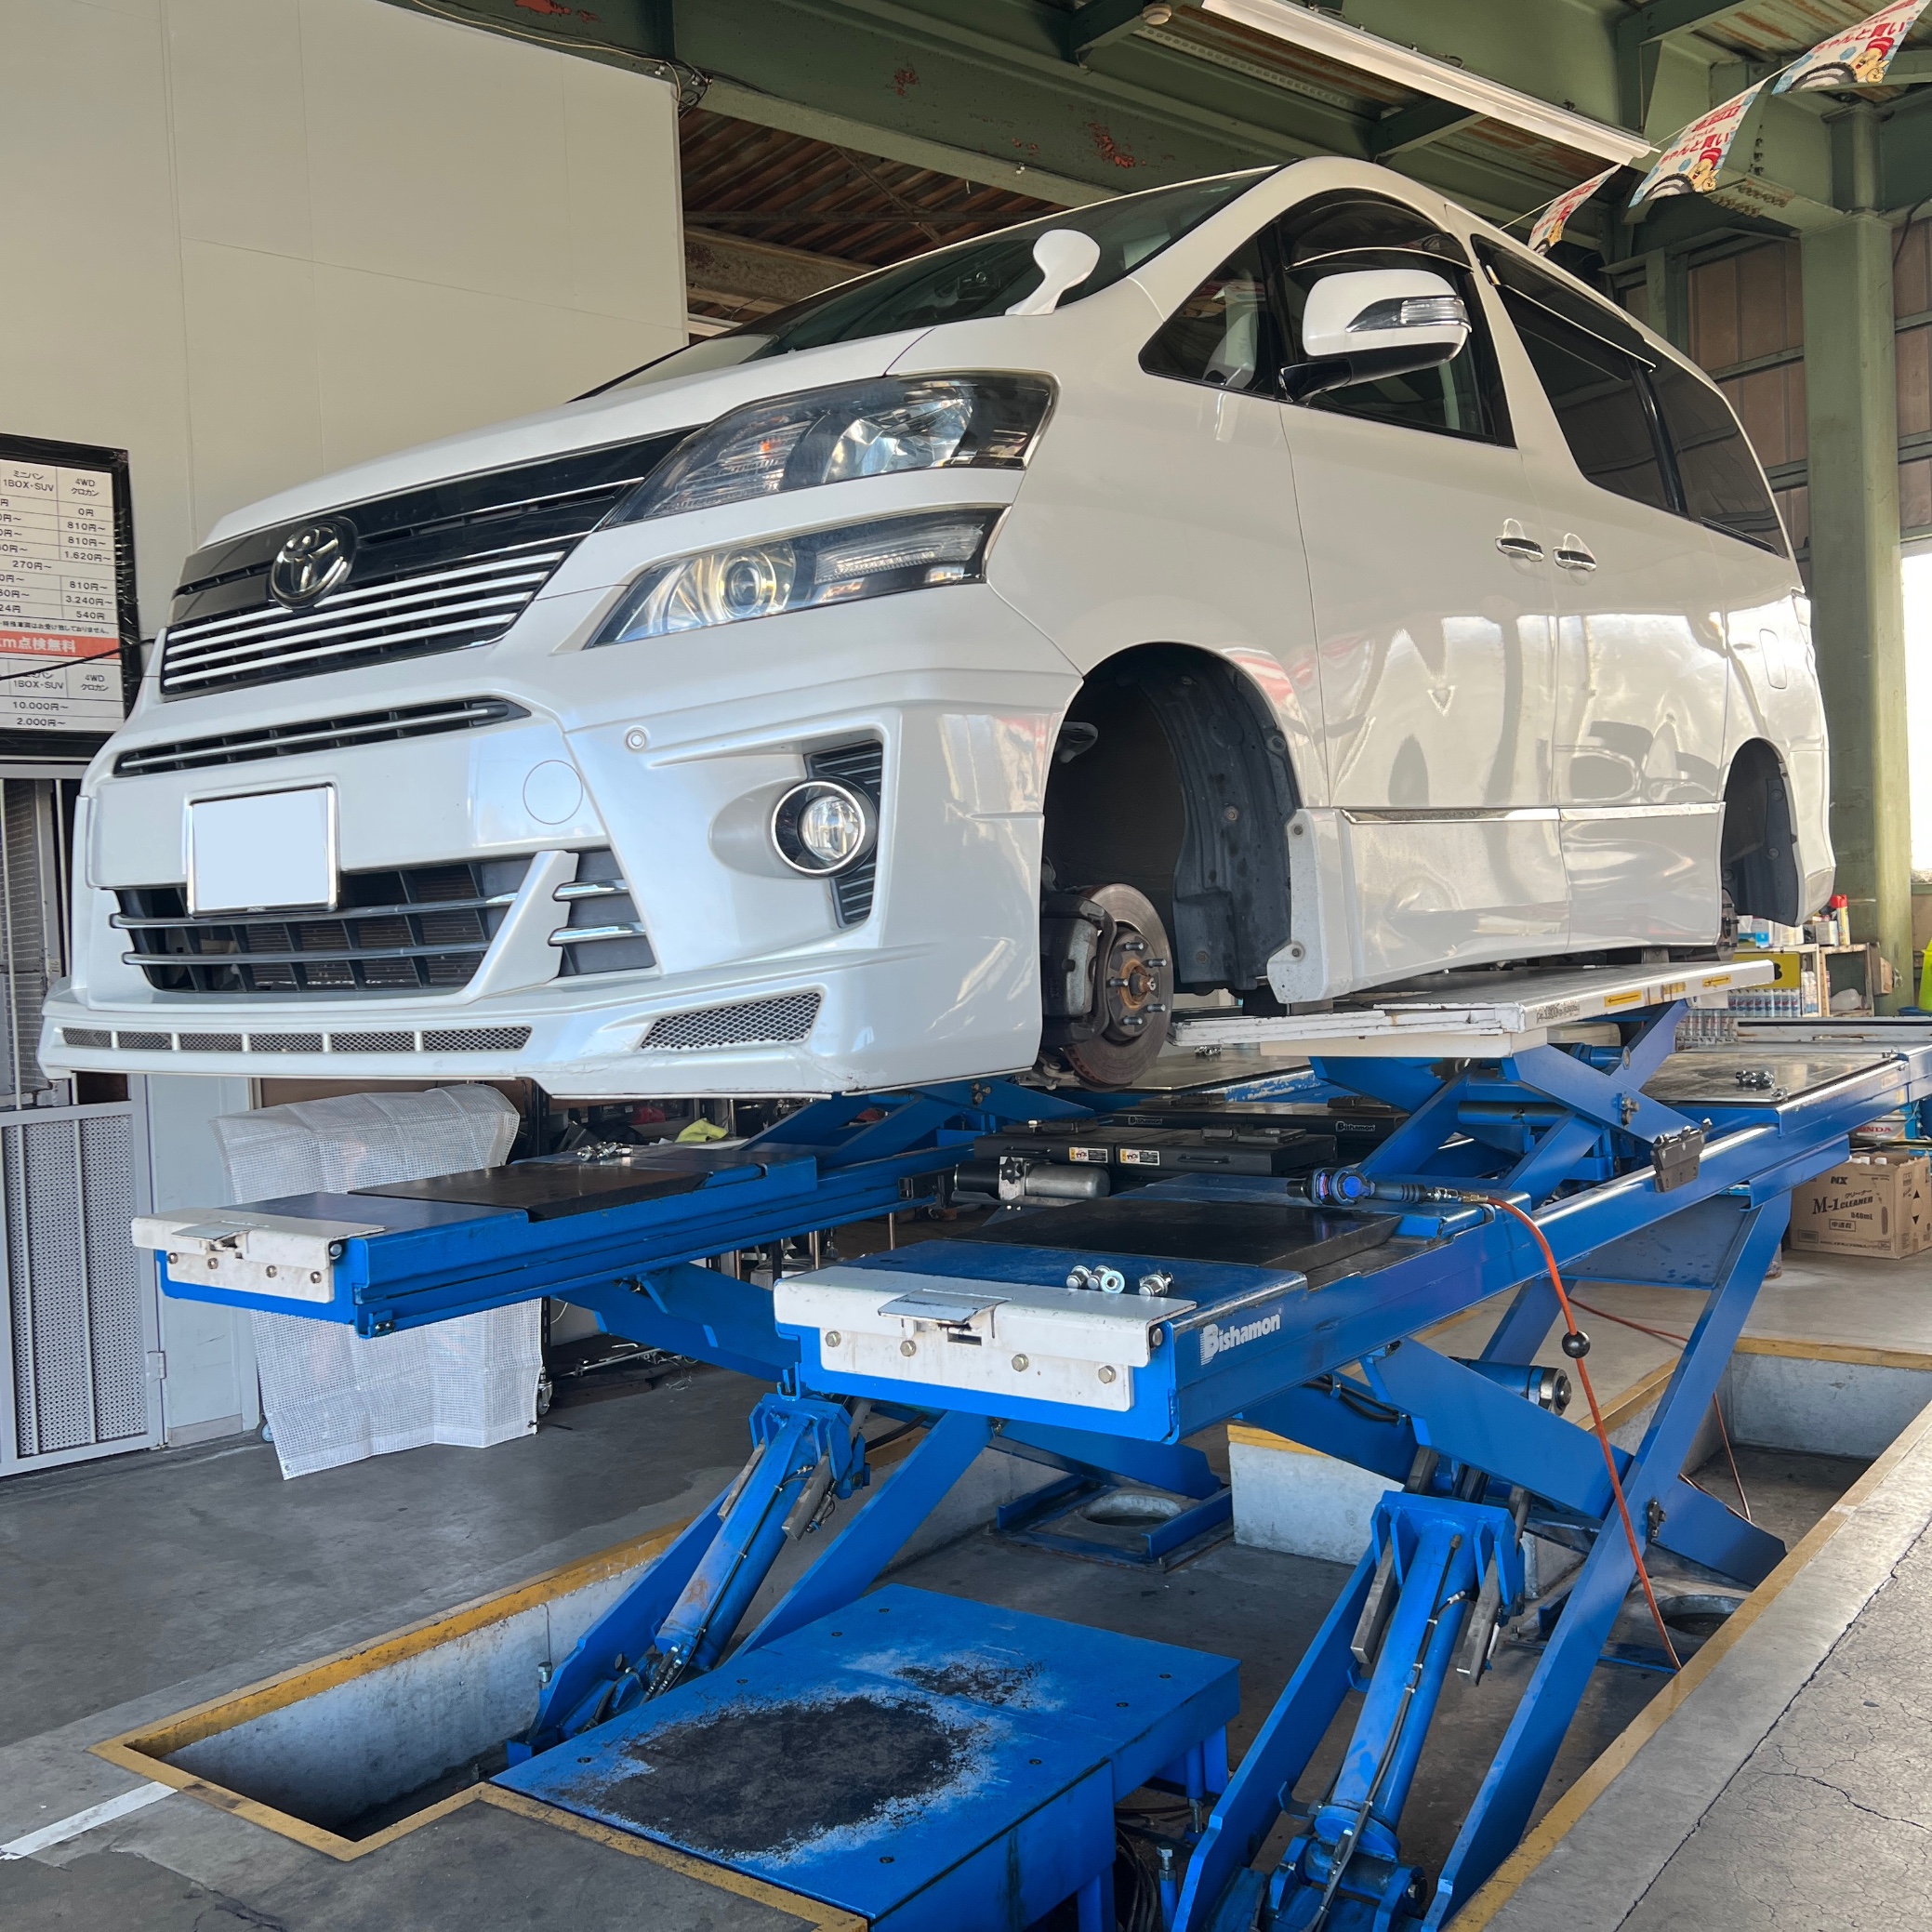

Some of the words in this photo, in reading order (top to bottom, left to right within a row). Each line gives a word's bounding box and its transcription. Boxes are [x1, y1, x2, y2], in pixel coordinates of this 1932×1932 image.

[13, 470, 44, 480] ミニバン
[75, 478, 96, 487] 4WD
[71, 487, 99, 496] クロカン
[78, 508, 94, 517] 0円
[76, 611, 105, 620] 540円
[81, 683, 109, 692] クロカン
[1335, 1120, 1376, 1132] Bishamon
[1200, 1314, 1282, 1366] Bishamon
